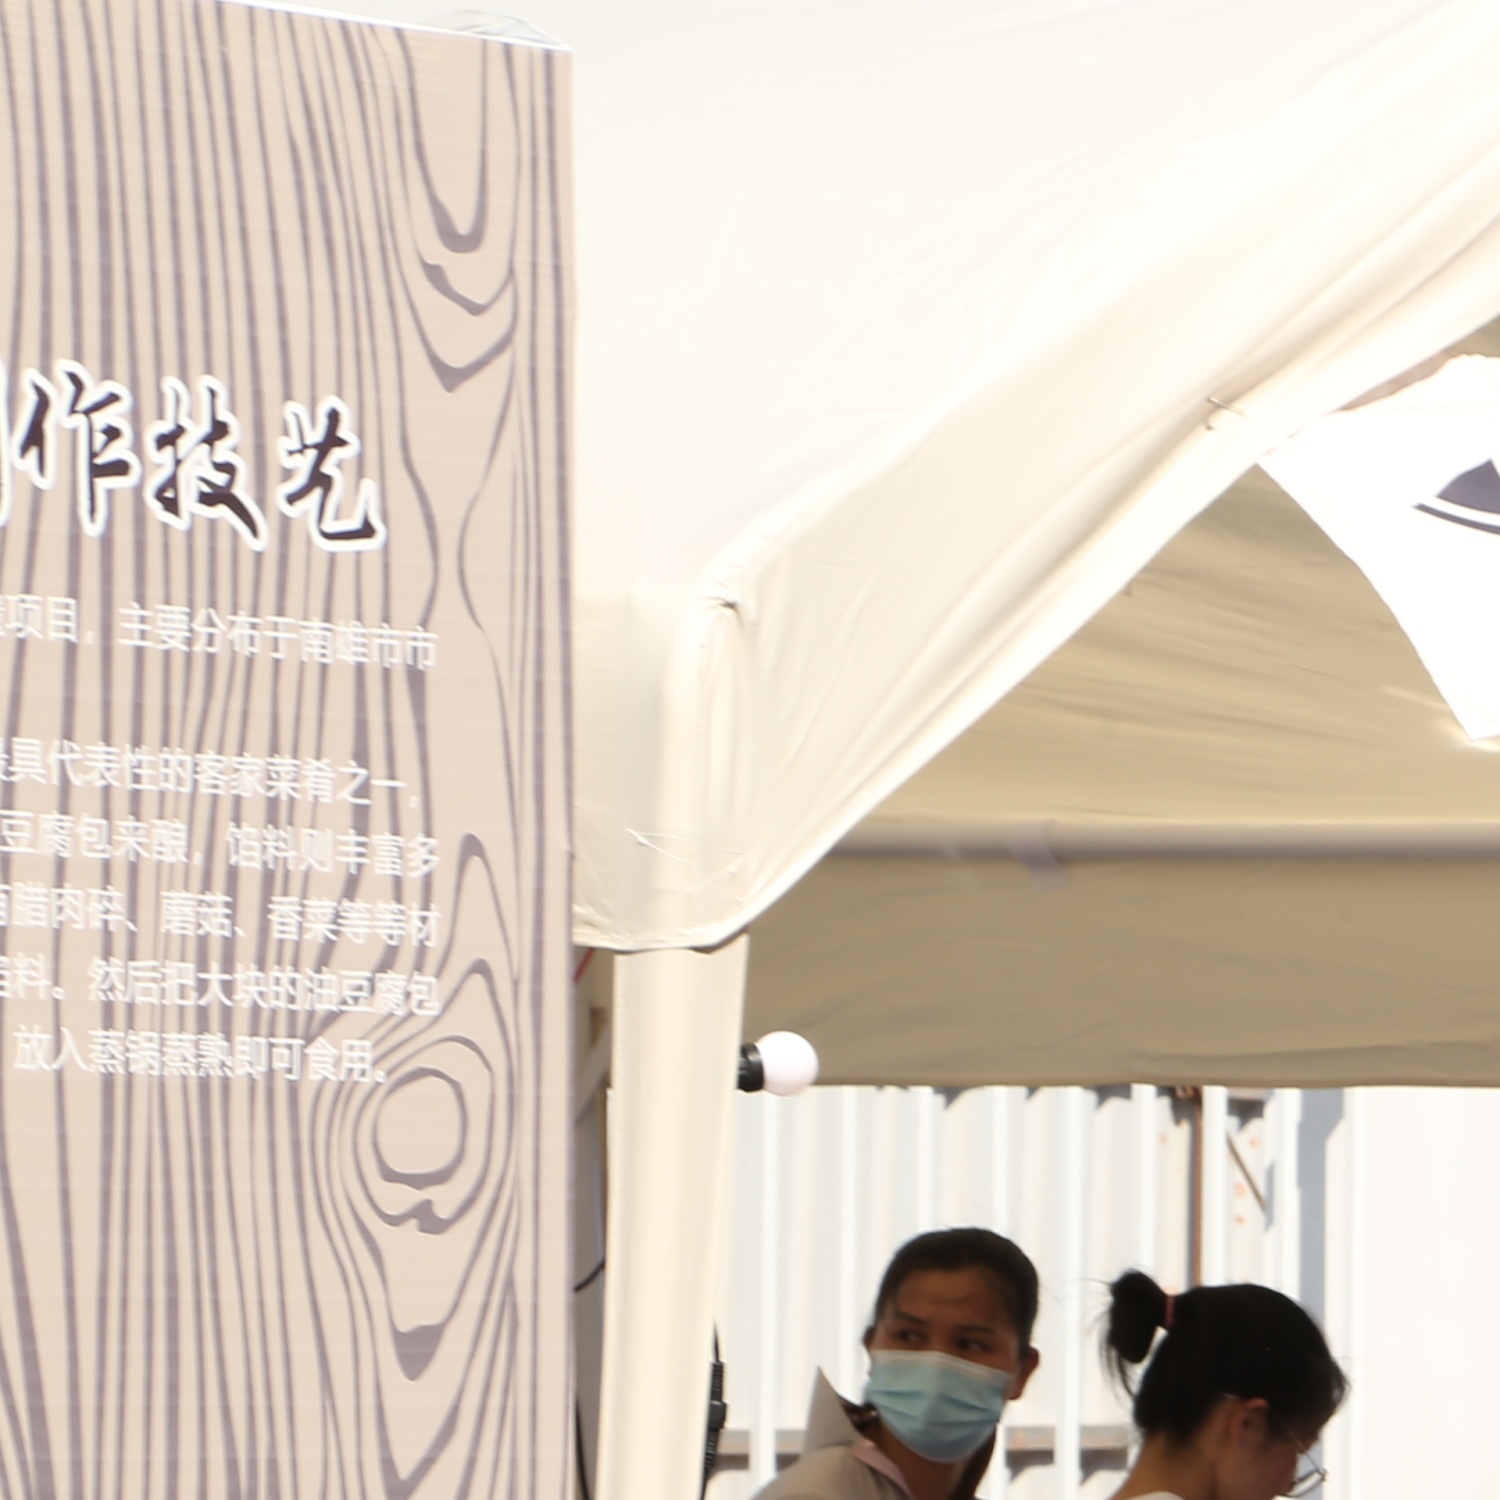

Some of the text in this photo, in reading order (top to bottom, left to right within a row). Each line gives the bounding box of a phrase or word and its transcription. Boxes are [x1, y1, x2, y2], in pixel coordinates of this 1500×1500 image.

[0, 360, 388, 550] 作技艺
[0, 737, 420, 808] 具代表性的客家菜肴之一，
